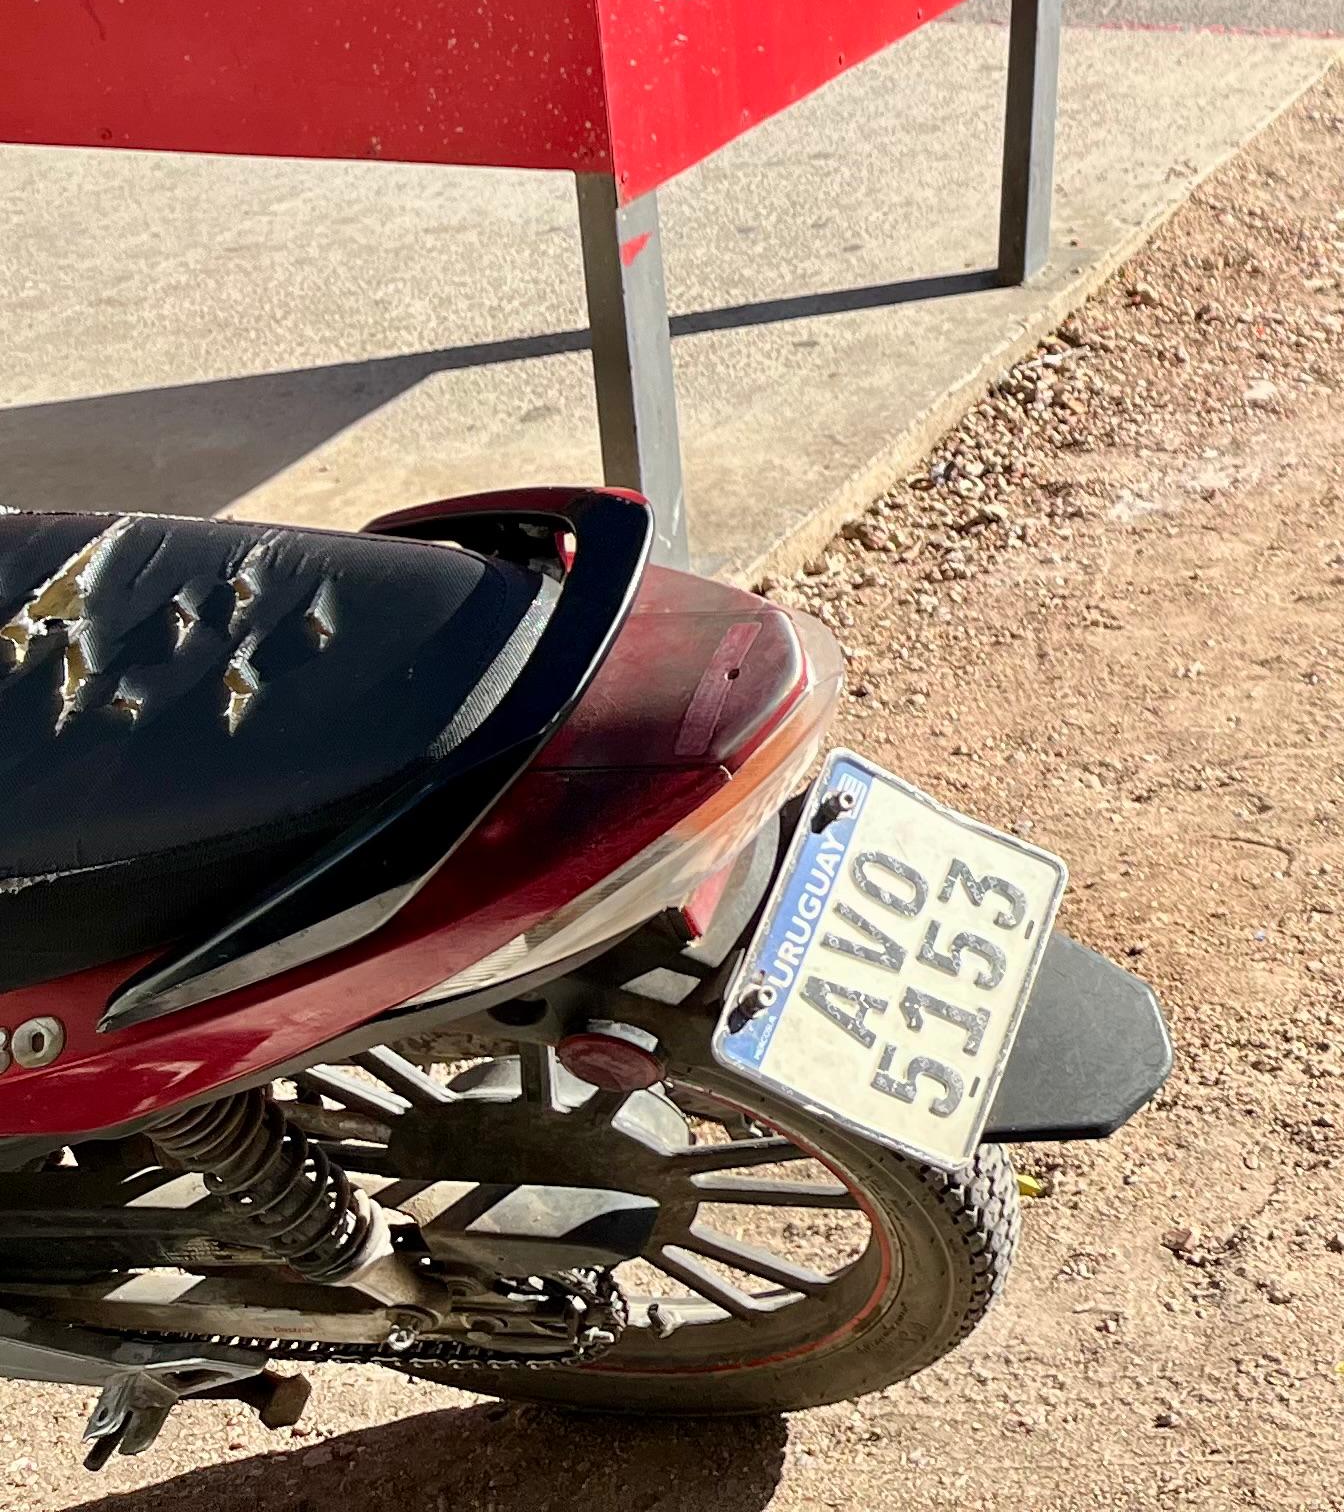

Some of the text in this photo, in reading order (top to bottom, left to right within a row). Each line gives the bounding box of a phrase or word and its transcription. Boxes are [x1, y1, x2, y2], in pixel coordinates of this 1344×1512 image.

[767, 826, 845, 988] URUGUAY
[800, 850, 929, 1049] AVO
[871, 857, 1027, 1119] 5153
